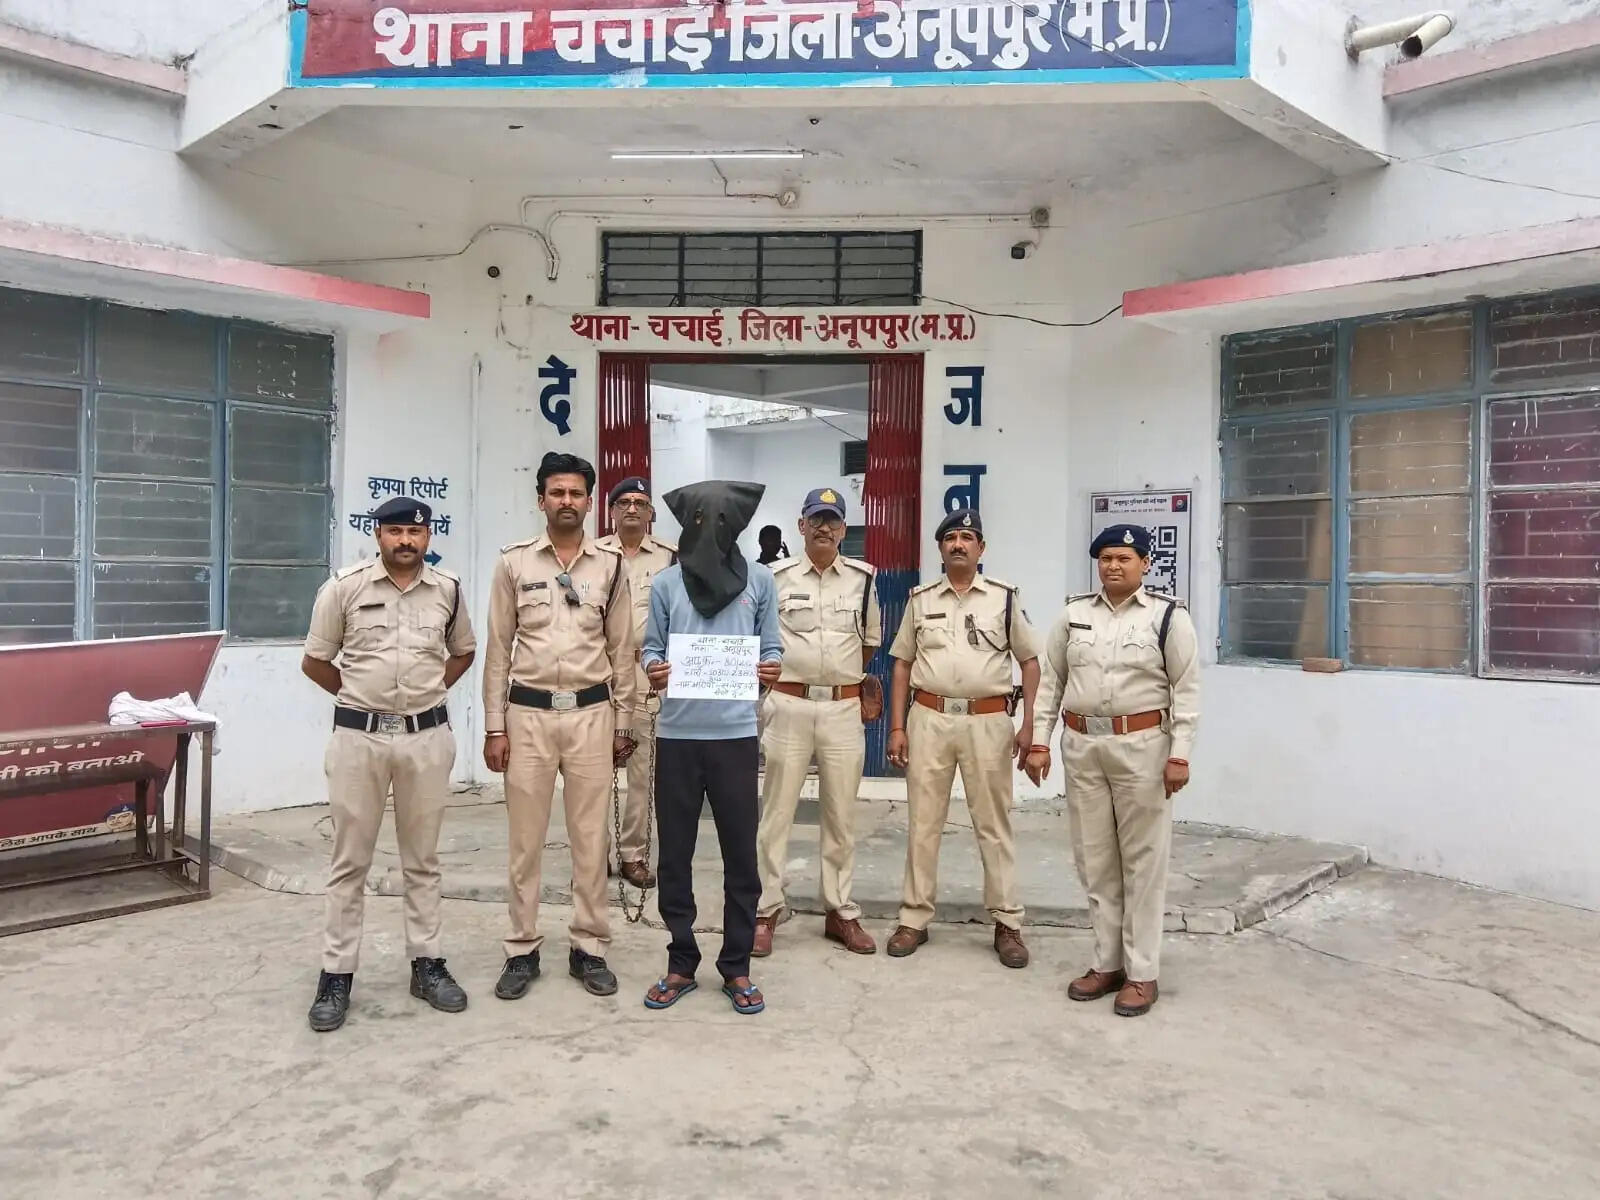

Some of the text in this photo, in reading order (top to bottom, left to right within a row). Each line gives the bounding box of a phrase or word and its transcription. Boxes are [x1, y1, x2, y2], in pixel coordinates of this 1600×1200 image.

[373, 7, 533, 67] थाना
[368, 476, 449, 499] कृपया रिपोर्ट
[25, 760, 62, 777] को
